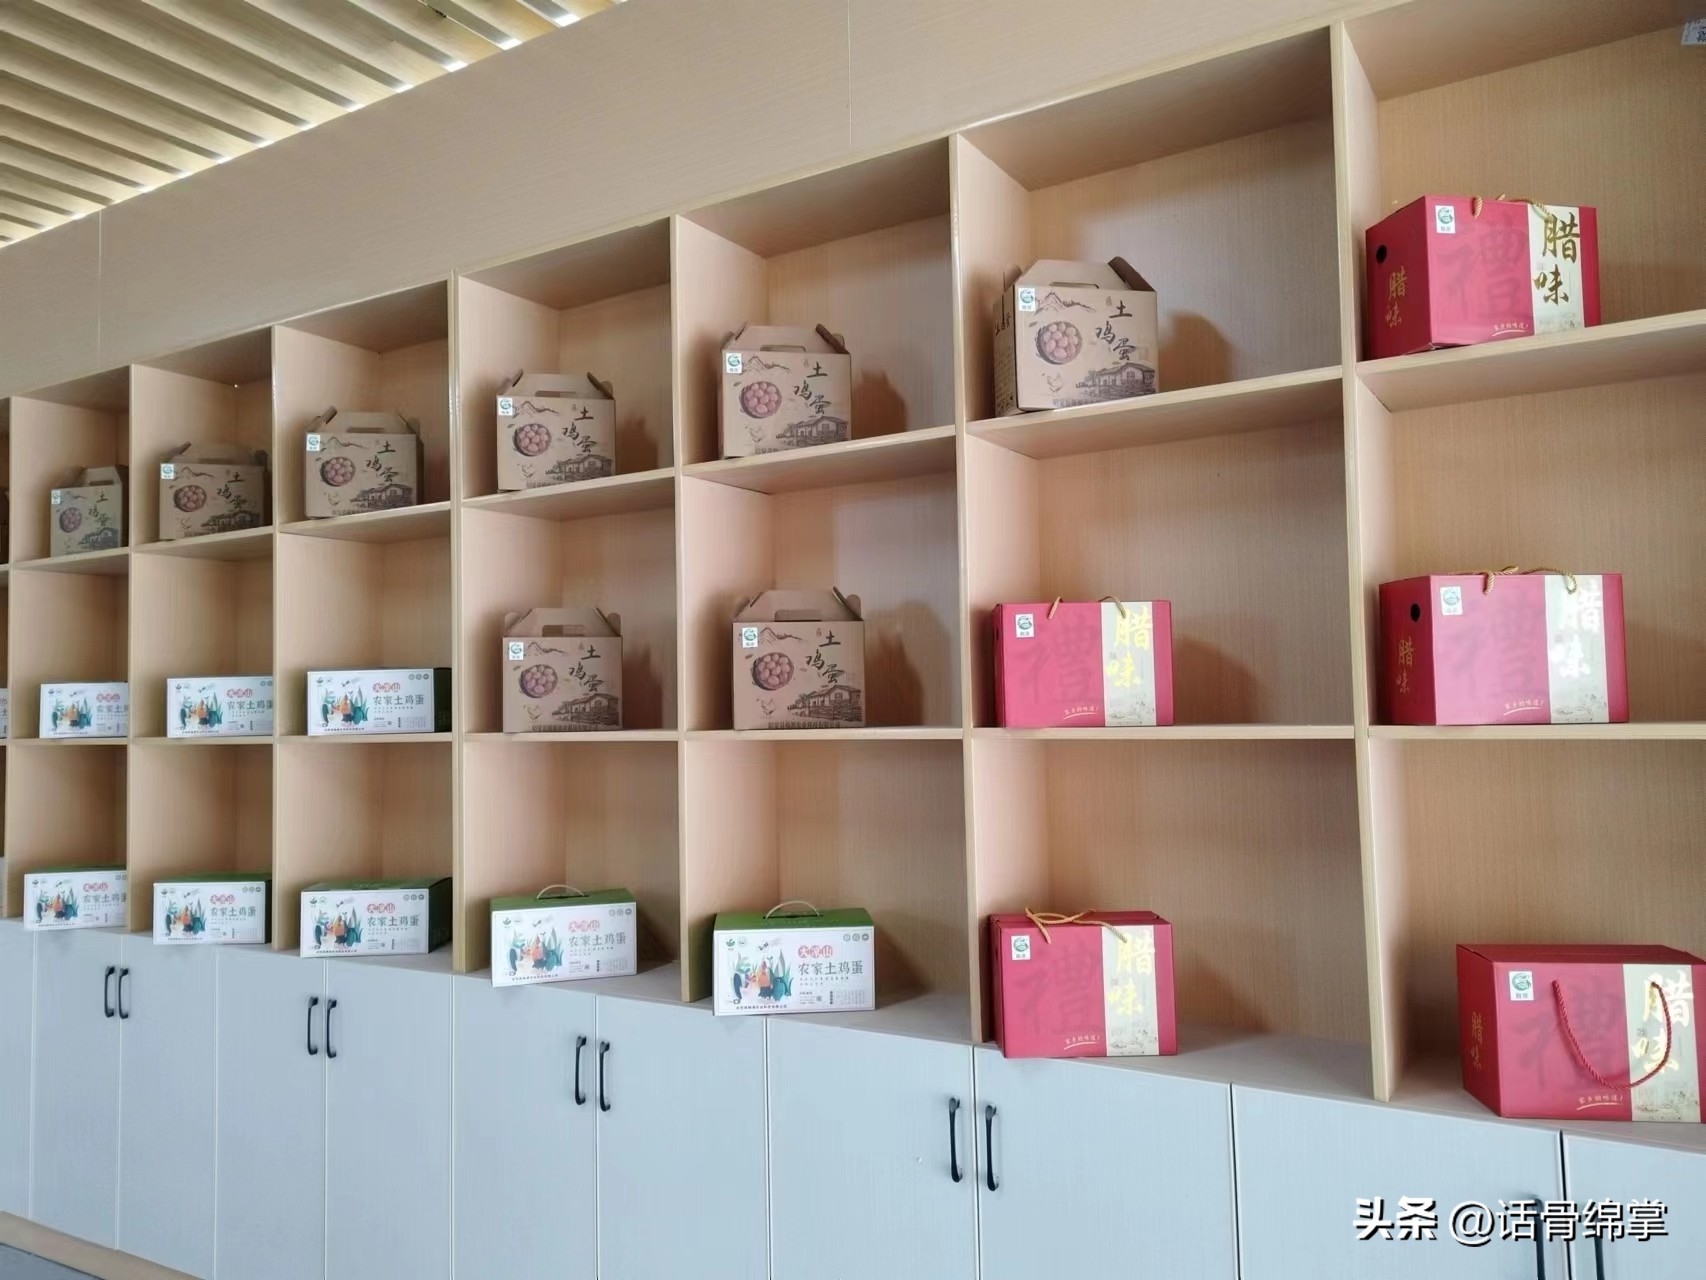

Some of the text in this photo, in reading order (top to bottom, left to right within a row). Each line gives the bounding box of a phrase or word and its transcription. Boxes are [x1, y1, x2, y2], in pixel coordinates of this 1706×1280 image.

[1533, 212, 1581, 305] 腊味
[1385, 264, 1408, 327] 腊味
[1095, 300, 1137, 361] 土鸡蛋
[793, 361, 831, 415] 土鸡蛋
[562, 406, 598, 454] 土鸡蛋
[365, 440, 400, 483] 土鸡蛋
[216, 472, 249, 510] 土鸡蛋
[568, 645, 604, 692] 土鸡蛋
[806, 630, 846, 683] 土鸡蛋
[1104, 605, 1153, 688] 腊味
[1395, 636, 1414, 695] 腊味
[373, 694, 424, 706] 农家土鸡蛋
[367, 914, 419, 927] 农家土鸡蛋
[568, 932, 626, 947] 农家土鸡蛋
[798, 960, 864, 975] 农家土鸡蛋
[1106, 929, 1156, 1016] 腊味
[1631, 970, 1694, 1074] 腊味
